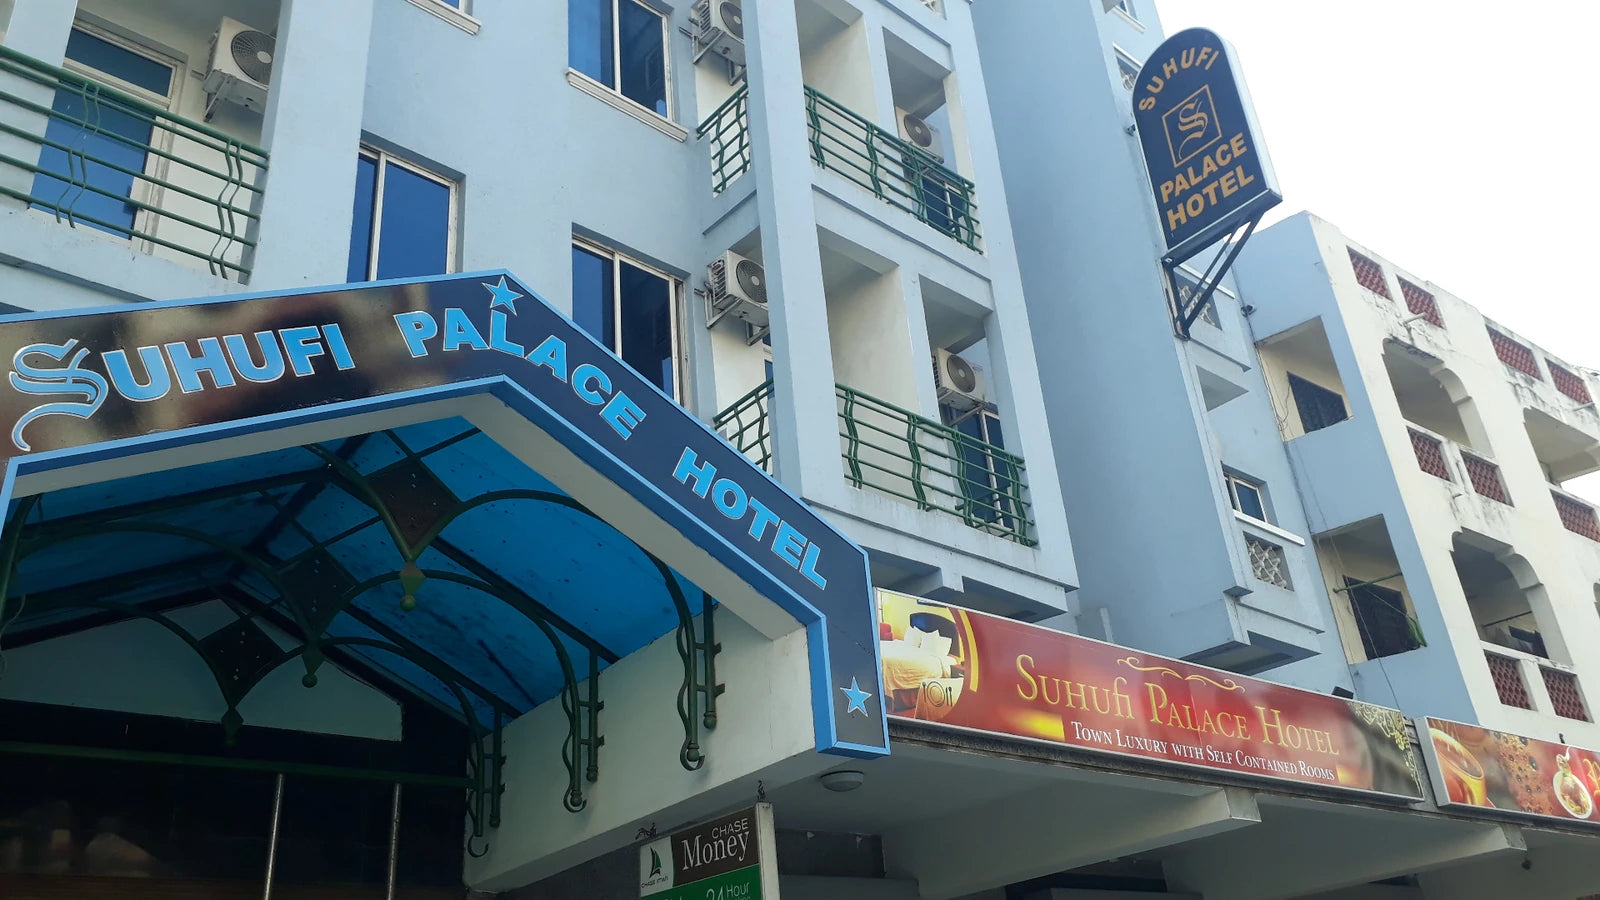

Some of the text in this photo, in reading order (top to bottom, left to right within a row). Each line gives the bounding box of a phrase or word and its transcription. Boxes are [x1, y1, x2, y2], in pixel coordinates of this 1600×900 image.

[1138, 46, 1219, 111] SUHUFI
[1159, 132, 1248, 203] PALACE
[1166, 164, 1255, 231] HOTEL
[9, 307, 828, 591] SUHUFI PALACE HOTEL
[681, 831, 750, 871] Money
[711, 818, 749, 840] CHASE
